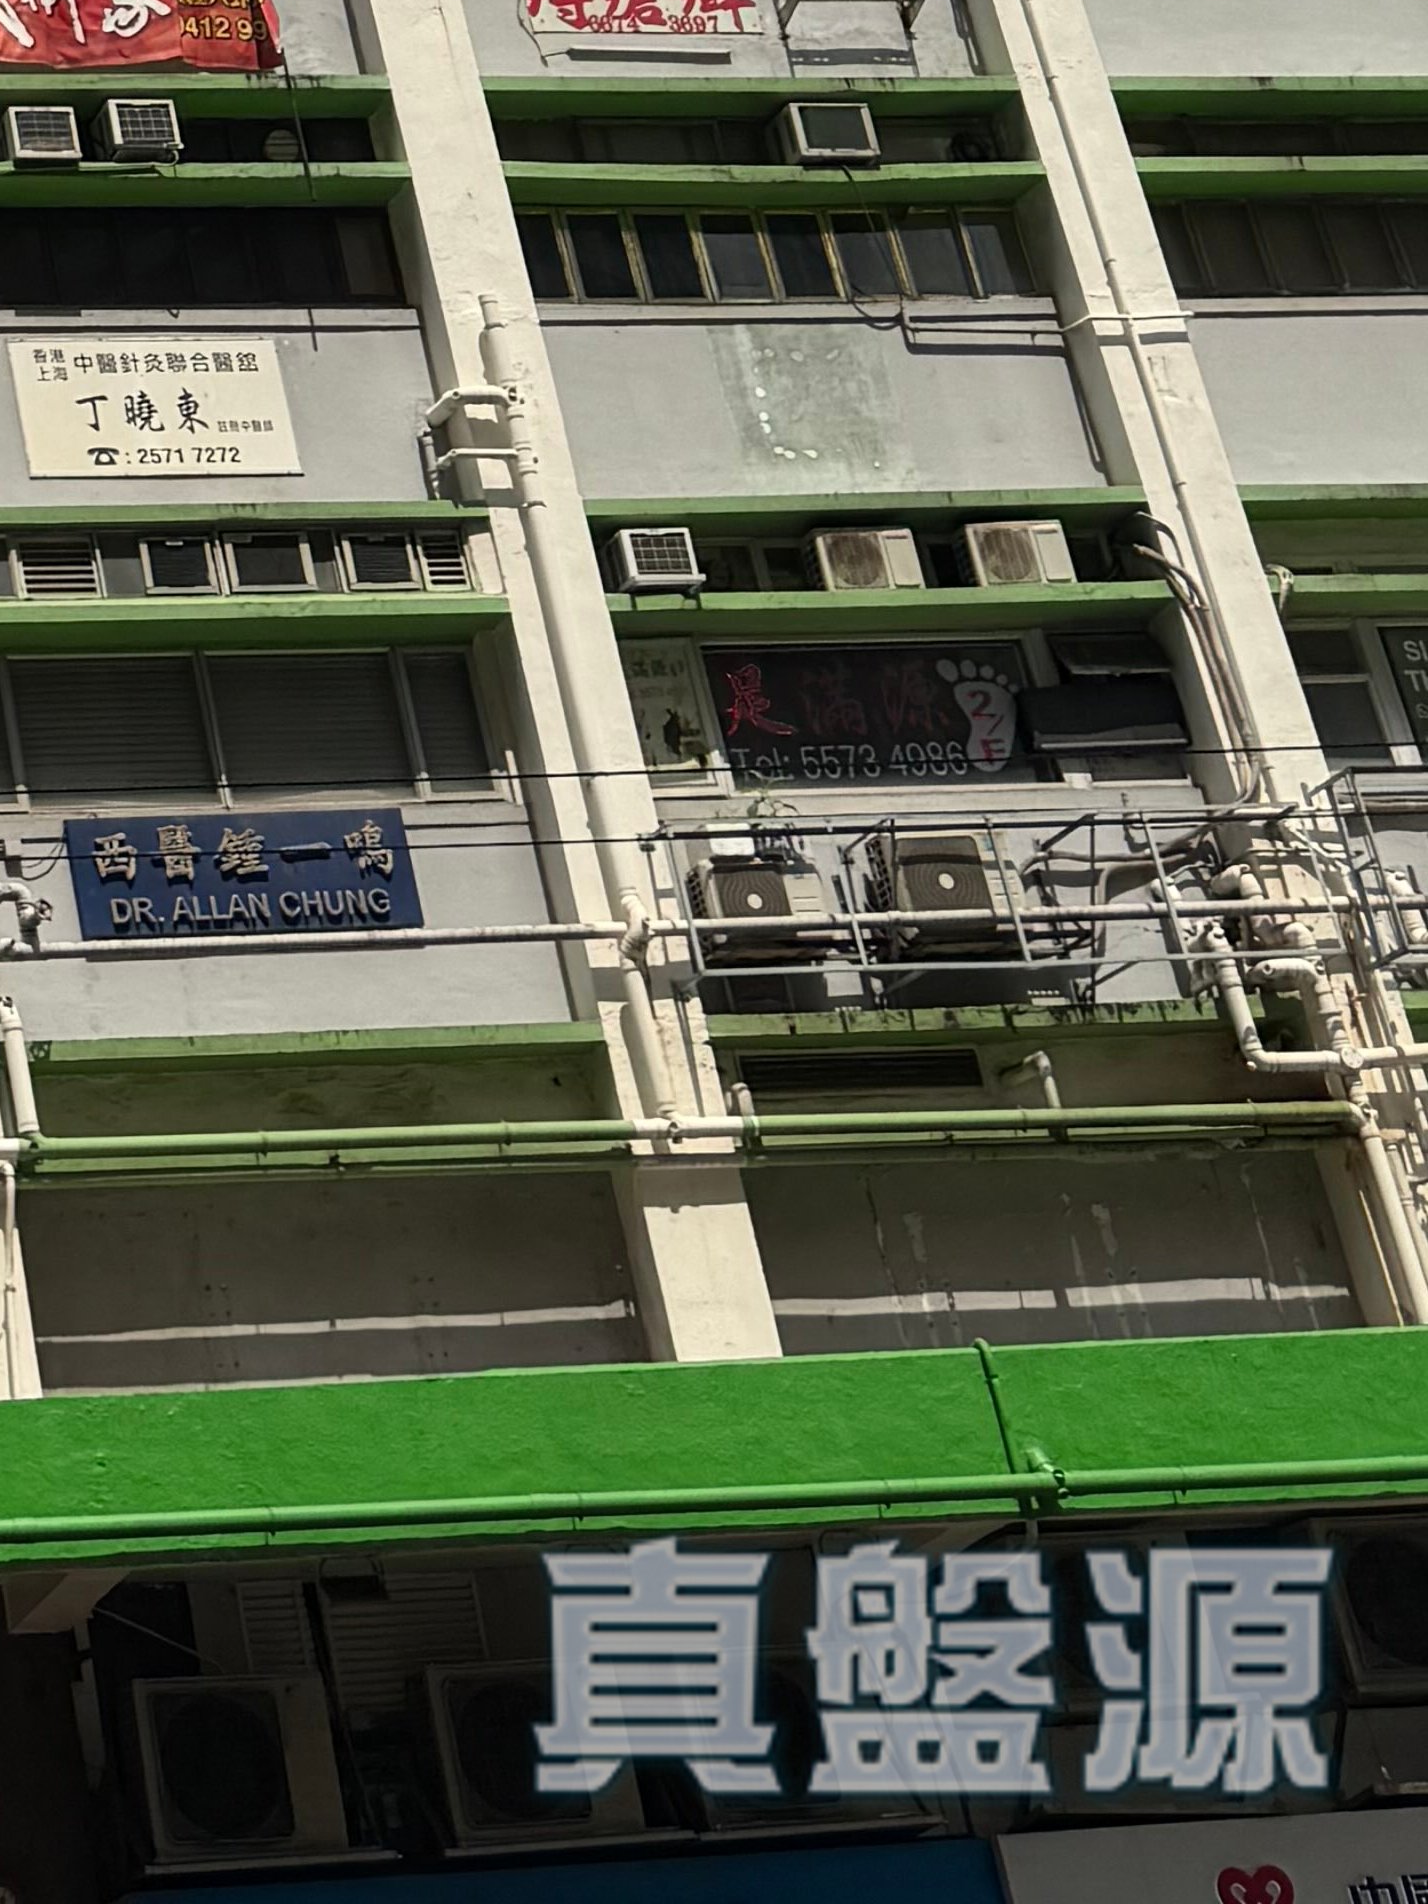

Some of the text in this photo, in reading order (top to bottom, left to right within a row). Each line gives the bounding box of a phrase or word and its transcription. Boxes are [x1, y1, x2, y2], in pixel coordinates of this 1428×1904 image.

[75, 387, 210, 434] 丁曉東
[137, 446, 242, 464] 2571 7272
[800, 744, 881, 780] 5573
[889, 740, 968, 777] 4986
[110, 888, 391, 924] DR. ALLAN CHUNG
